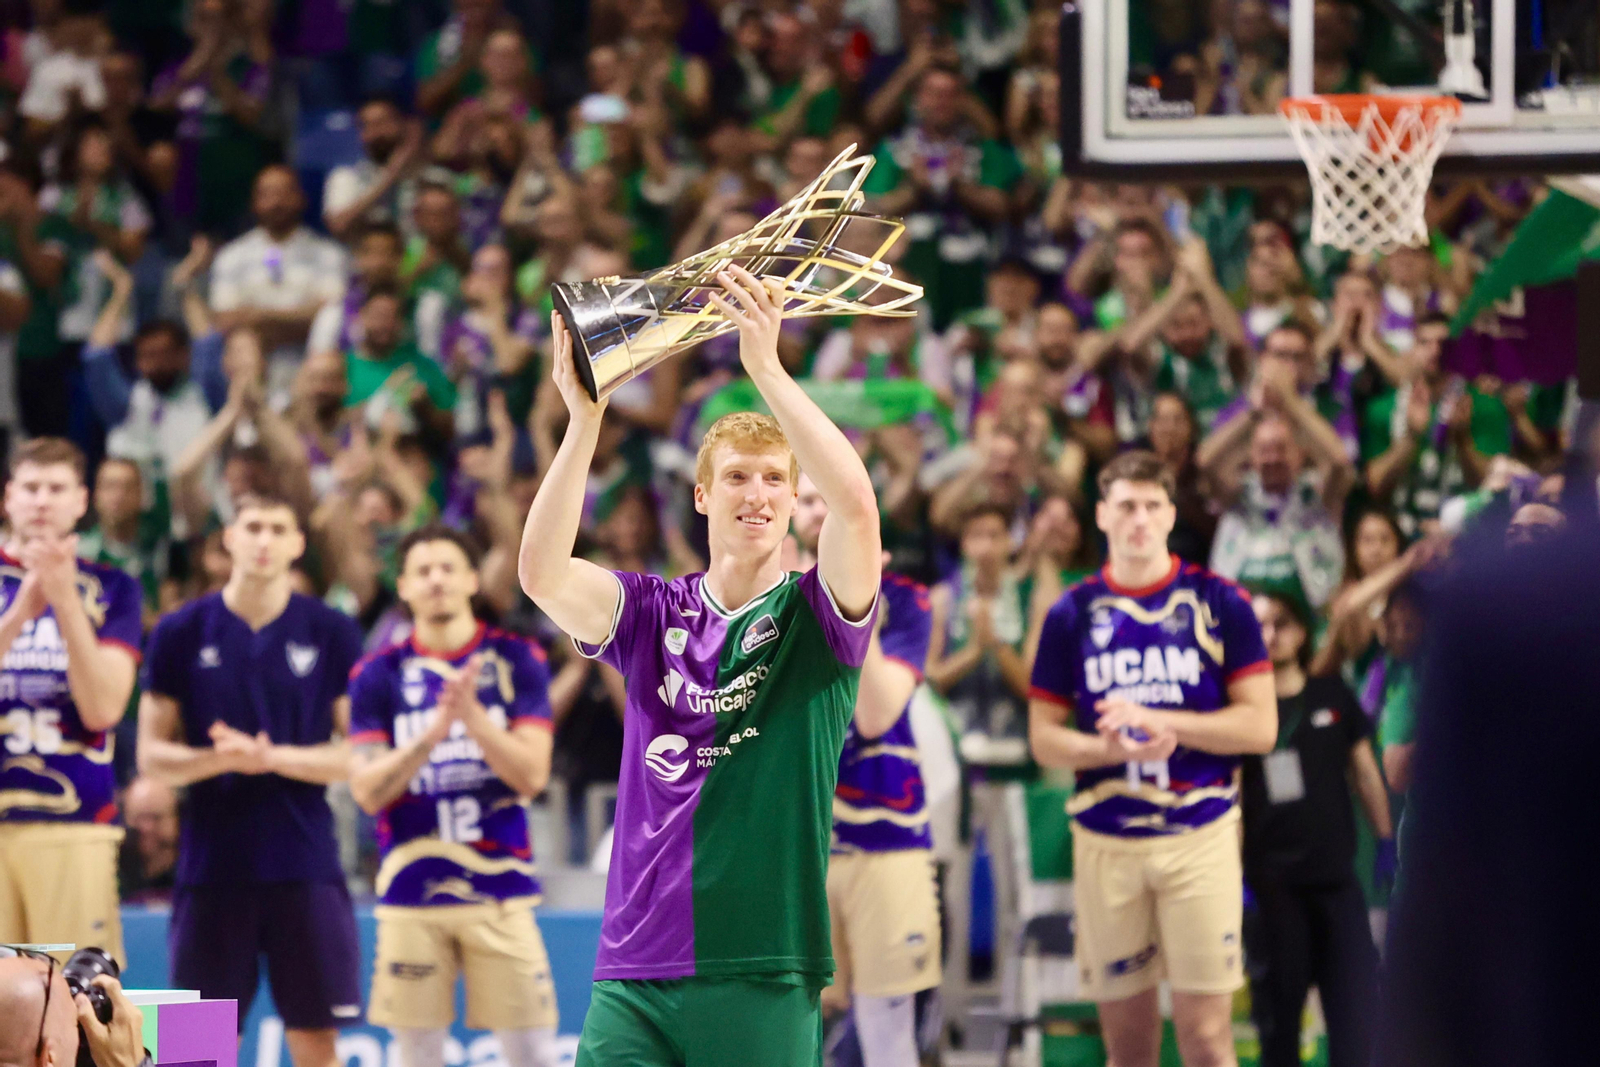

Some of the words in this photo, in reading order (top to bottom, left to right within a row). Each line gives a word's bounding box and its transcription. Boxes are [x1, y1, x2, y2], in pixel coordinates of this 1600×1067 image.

[745, 629, 776, 649] endesa
[1083, 645, 1200, 694] UCAM
[726, 733, 742, 744] EL
[436, 796, 483, 844] 12
